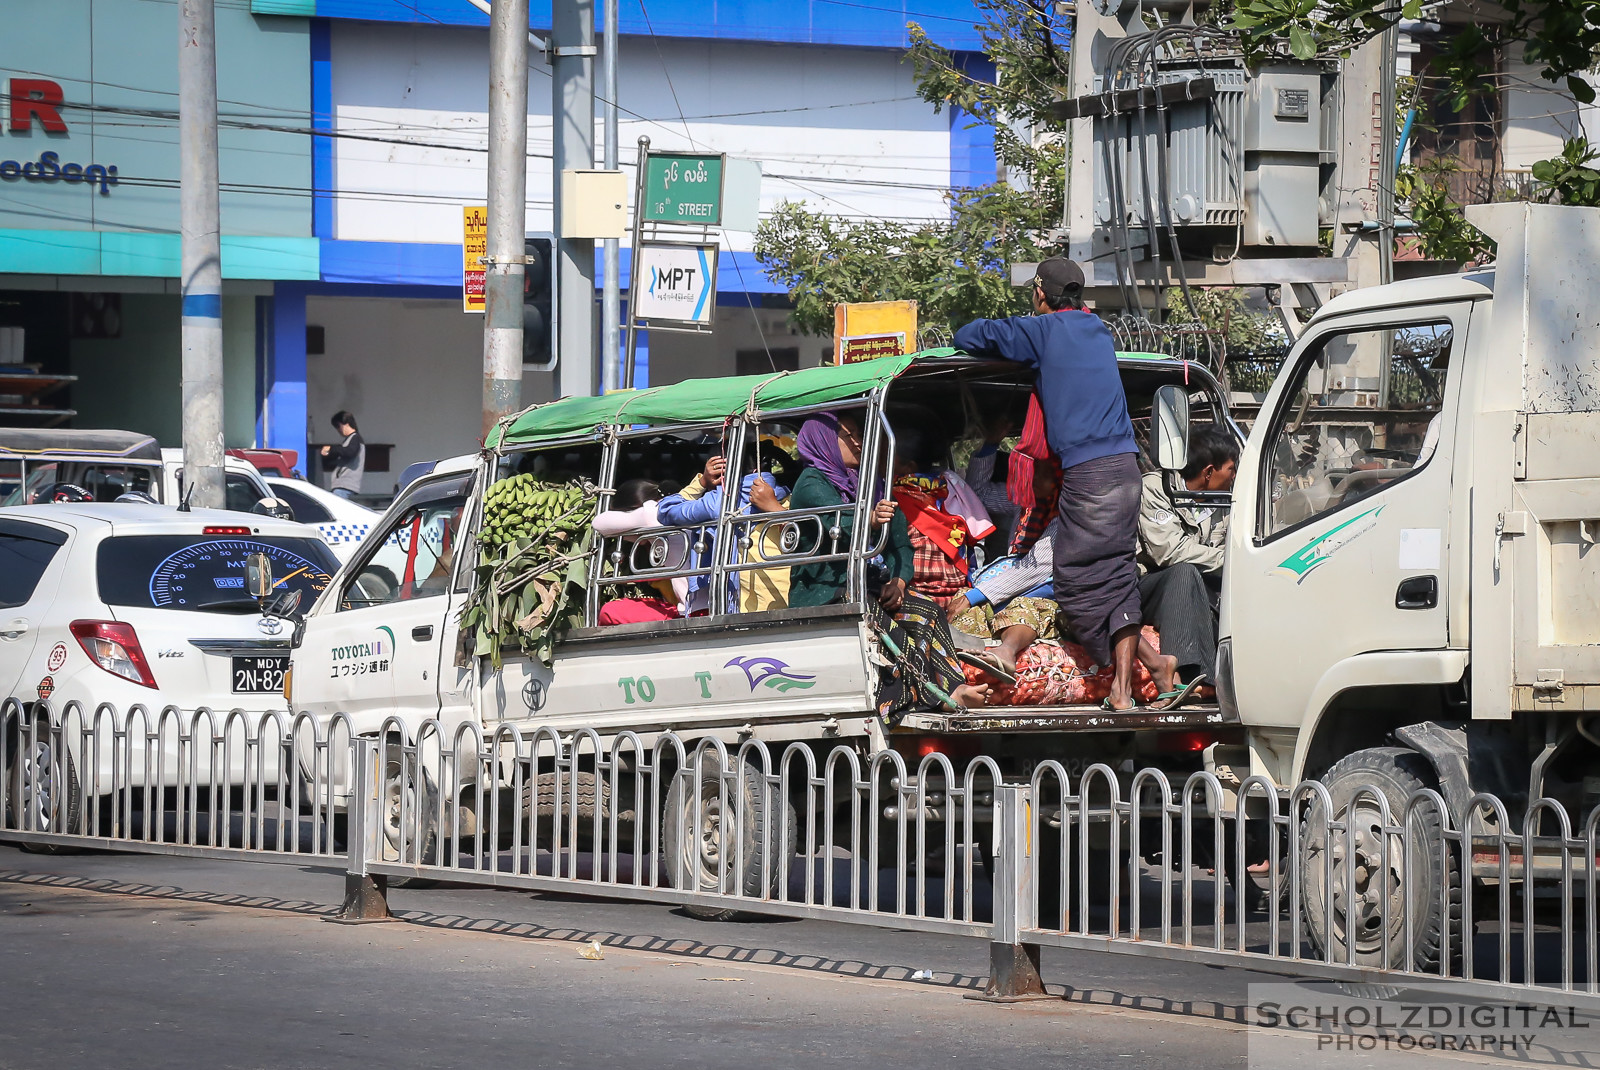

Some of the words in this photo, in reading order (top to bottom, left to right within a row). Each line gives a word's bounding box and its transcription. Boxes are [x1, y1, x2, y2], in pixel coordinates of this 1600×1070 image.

[684, 160, 708, 183] လမ်း
[678, 203, 713, 216] STREET
[658, 267, 696, 290] MPT
[52, 650, 64, 662] 95
[331, 643, 371, 661] TOYOTA
[257, 658, 282, 669] MDY
[236, 669, 290, 691] 2N-82
[618, 675, 656, 704] TO
